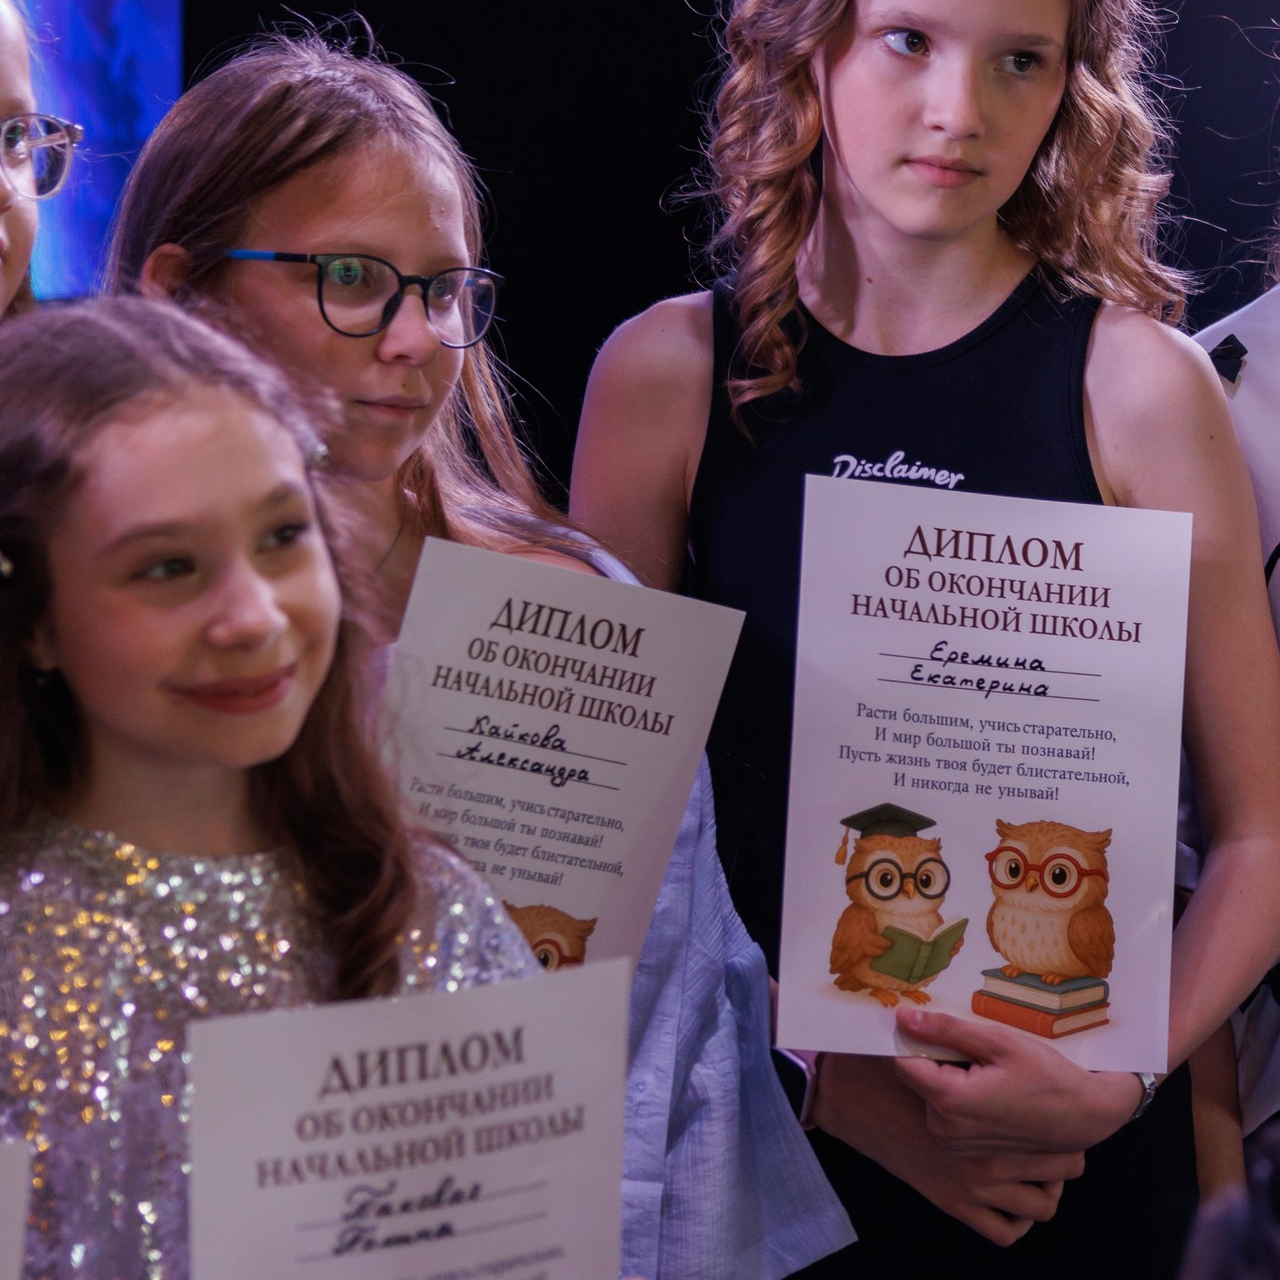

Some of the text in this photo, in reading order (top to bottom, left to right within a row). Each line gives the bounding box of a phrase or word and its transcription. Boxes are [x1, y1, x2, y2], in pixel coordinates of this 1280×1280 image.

[832, 451, 964, 488] Disclaimer
[903, 525, 1085, 572] ДИПЛОМ
[885, 566, 1112, 609] ОБ ОКОНЧАНИИ
[489, 597, 646, 658] ДИПЛОМ
[851, 593, 1143, 643] НАЧАЛЬНОЙ ШКОЛЫ
[468, 637, 658, 698] ОБ ОКОНЧАНИИ
[929, 640, 1047, 672] Еремина
[431, 664, 675, 736] НАЧАЛЬНОЙ ШКОЛЫ
[910, 663, 1050, 699] Екатерина
[856, 702, 1117, 743] Расти большим, учись старательно,
[874, 726, 1096, 761] И мир большой ты познавай!
[455, 741, 590, 788] Александра
[839, 744, 1131, 787] Пусть жизнь твоя будет блистательной,
[447, 783, 507, 809] большим,
[509, 798, 546, 816] учись
[547, 805, 625, 833] старательно,
[893, 772, 1060, 802] И никогда не унывай!
[460, 808, 516, 832] большой
[520, 823, 537, 837] ты
[540, 827, 605, 849] познавай!
[464, 834, 491, 850] твоя
[493, 838, 529, 857] будет
[531, 846, 625, 877] блистательной,
[491, 863, 508, 877] не
[509, 866, 564, 887] унывай!
[317, 1025, 525, 1100] ДИПЛОМ
[296, 1108, 344, 1142] ОБ
